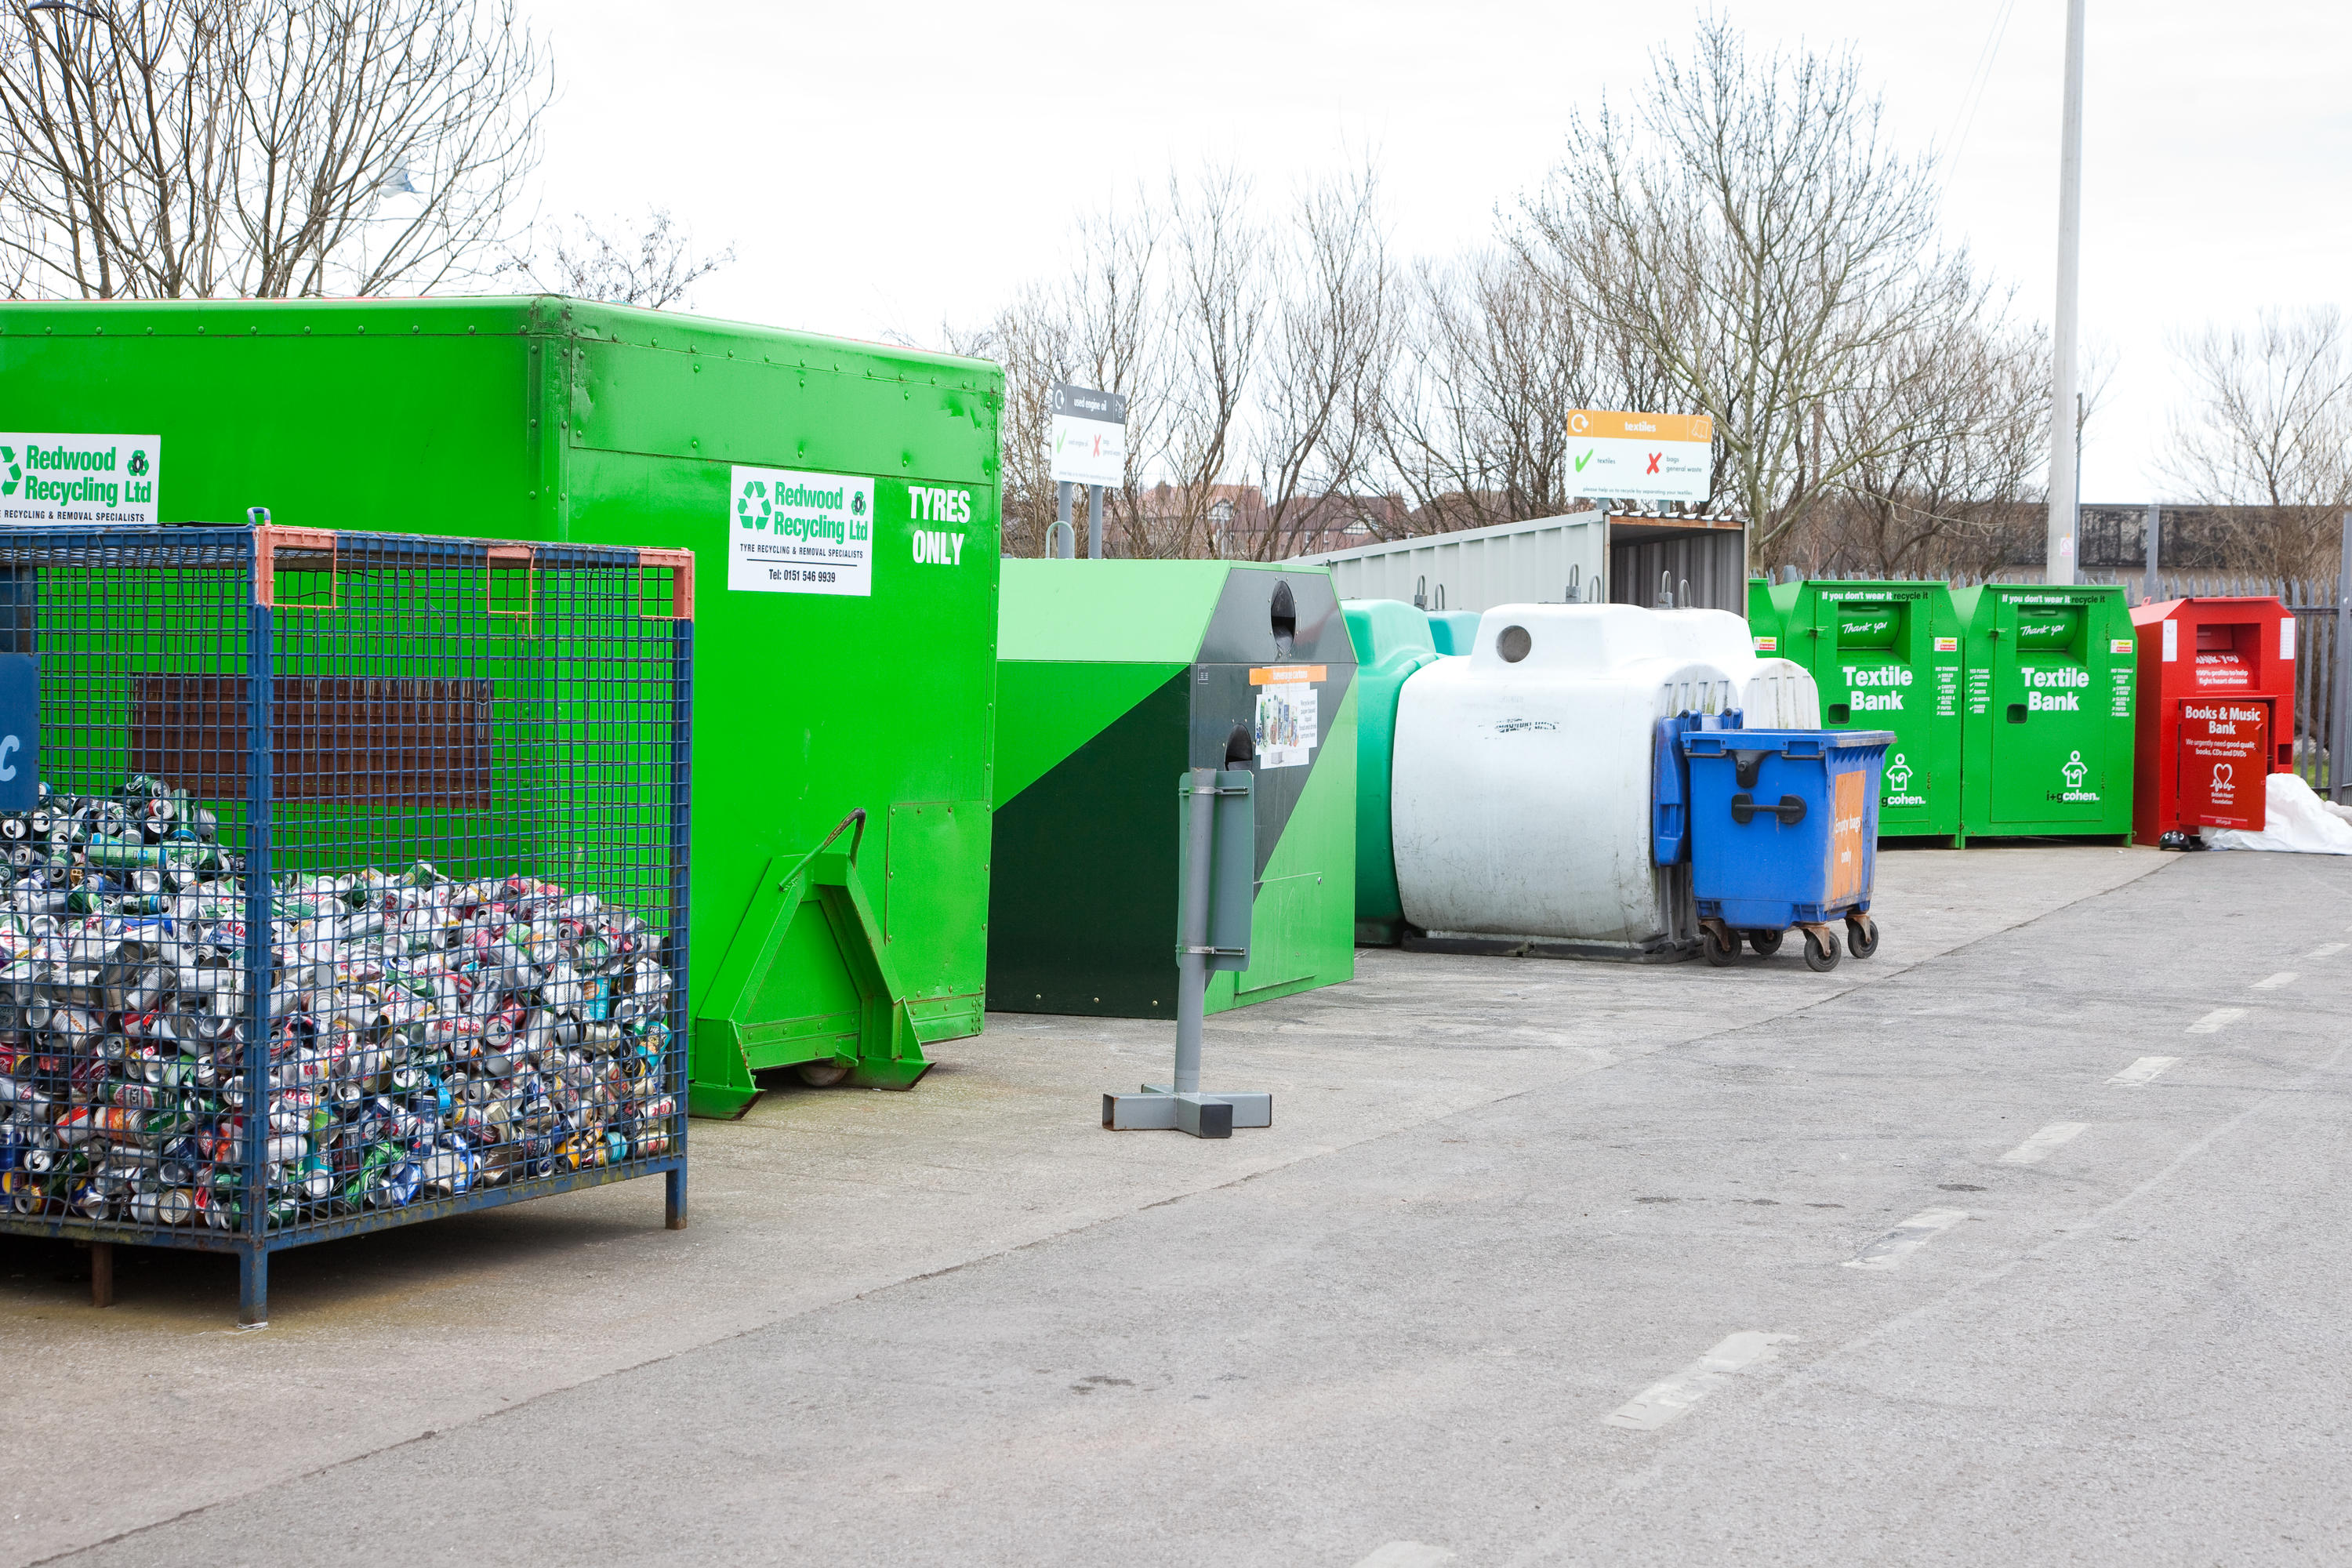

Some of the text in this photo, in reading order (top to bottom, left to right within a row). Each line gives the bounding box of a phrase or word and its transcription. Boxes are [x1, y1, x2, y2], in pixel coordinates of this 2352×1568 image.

[1074, 397, 1084, 408] used
[1624, 421, 1656, 433] textiles
[26, 445, 116, 470] Redwood
[25, 475, 151, 508] Recycling Ltd
[775, 481, 844, 510] Redwood
[908, 486, 971, 524] TYRES
[5, 510, 45, 519] RECYCLING
[57, 511, 93, 521] REMOVAL
[96, 512, 144, 522] SPECIALISTS
[774, 511, 868, 544] Recycling Ltd
[740, 543, 863, 558] TYRE RECYCLING & REMOVAL SPECIALISTS
[913, 530, 965, 564] ONLY
[769, 569, 836, 583] Tel: 0151 546 9939
[1822, 591, 1828, 600] If
[1830, 593, 1844, 601] you
[1846, 591, 1864, 600] don't
[1886, 591, 1893, 600] it
[1894, 592, 1921, 601] recycle
[2065, 594, 2070, 603] it
[2071, 596, 2098, 605] recycle
[1842, 622, 1888, 633] Thank you
[2020, 624, 2065, 637] Thank you
[1842, 665, 1913, 687] Textile
[2021, 667, 2089, 688] Textile
[2199, 677, 2212, 687] fight
[1850, 690, 1904, 710] Bank
[2029, 691, 2079, 711] Bank
[2186, 706, 2261, 721] Books & Music
[2209, 720, 2236, 735] Bank
[1849, 814, 1860, 833] bags
[1841, 847, 1852, 866] only
